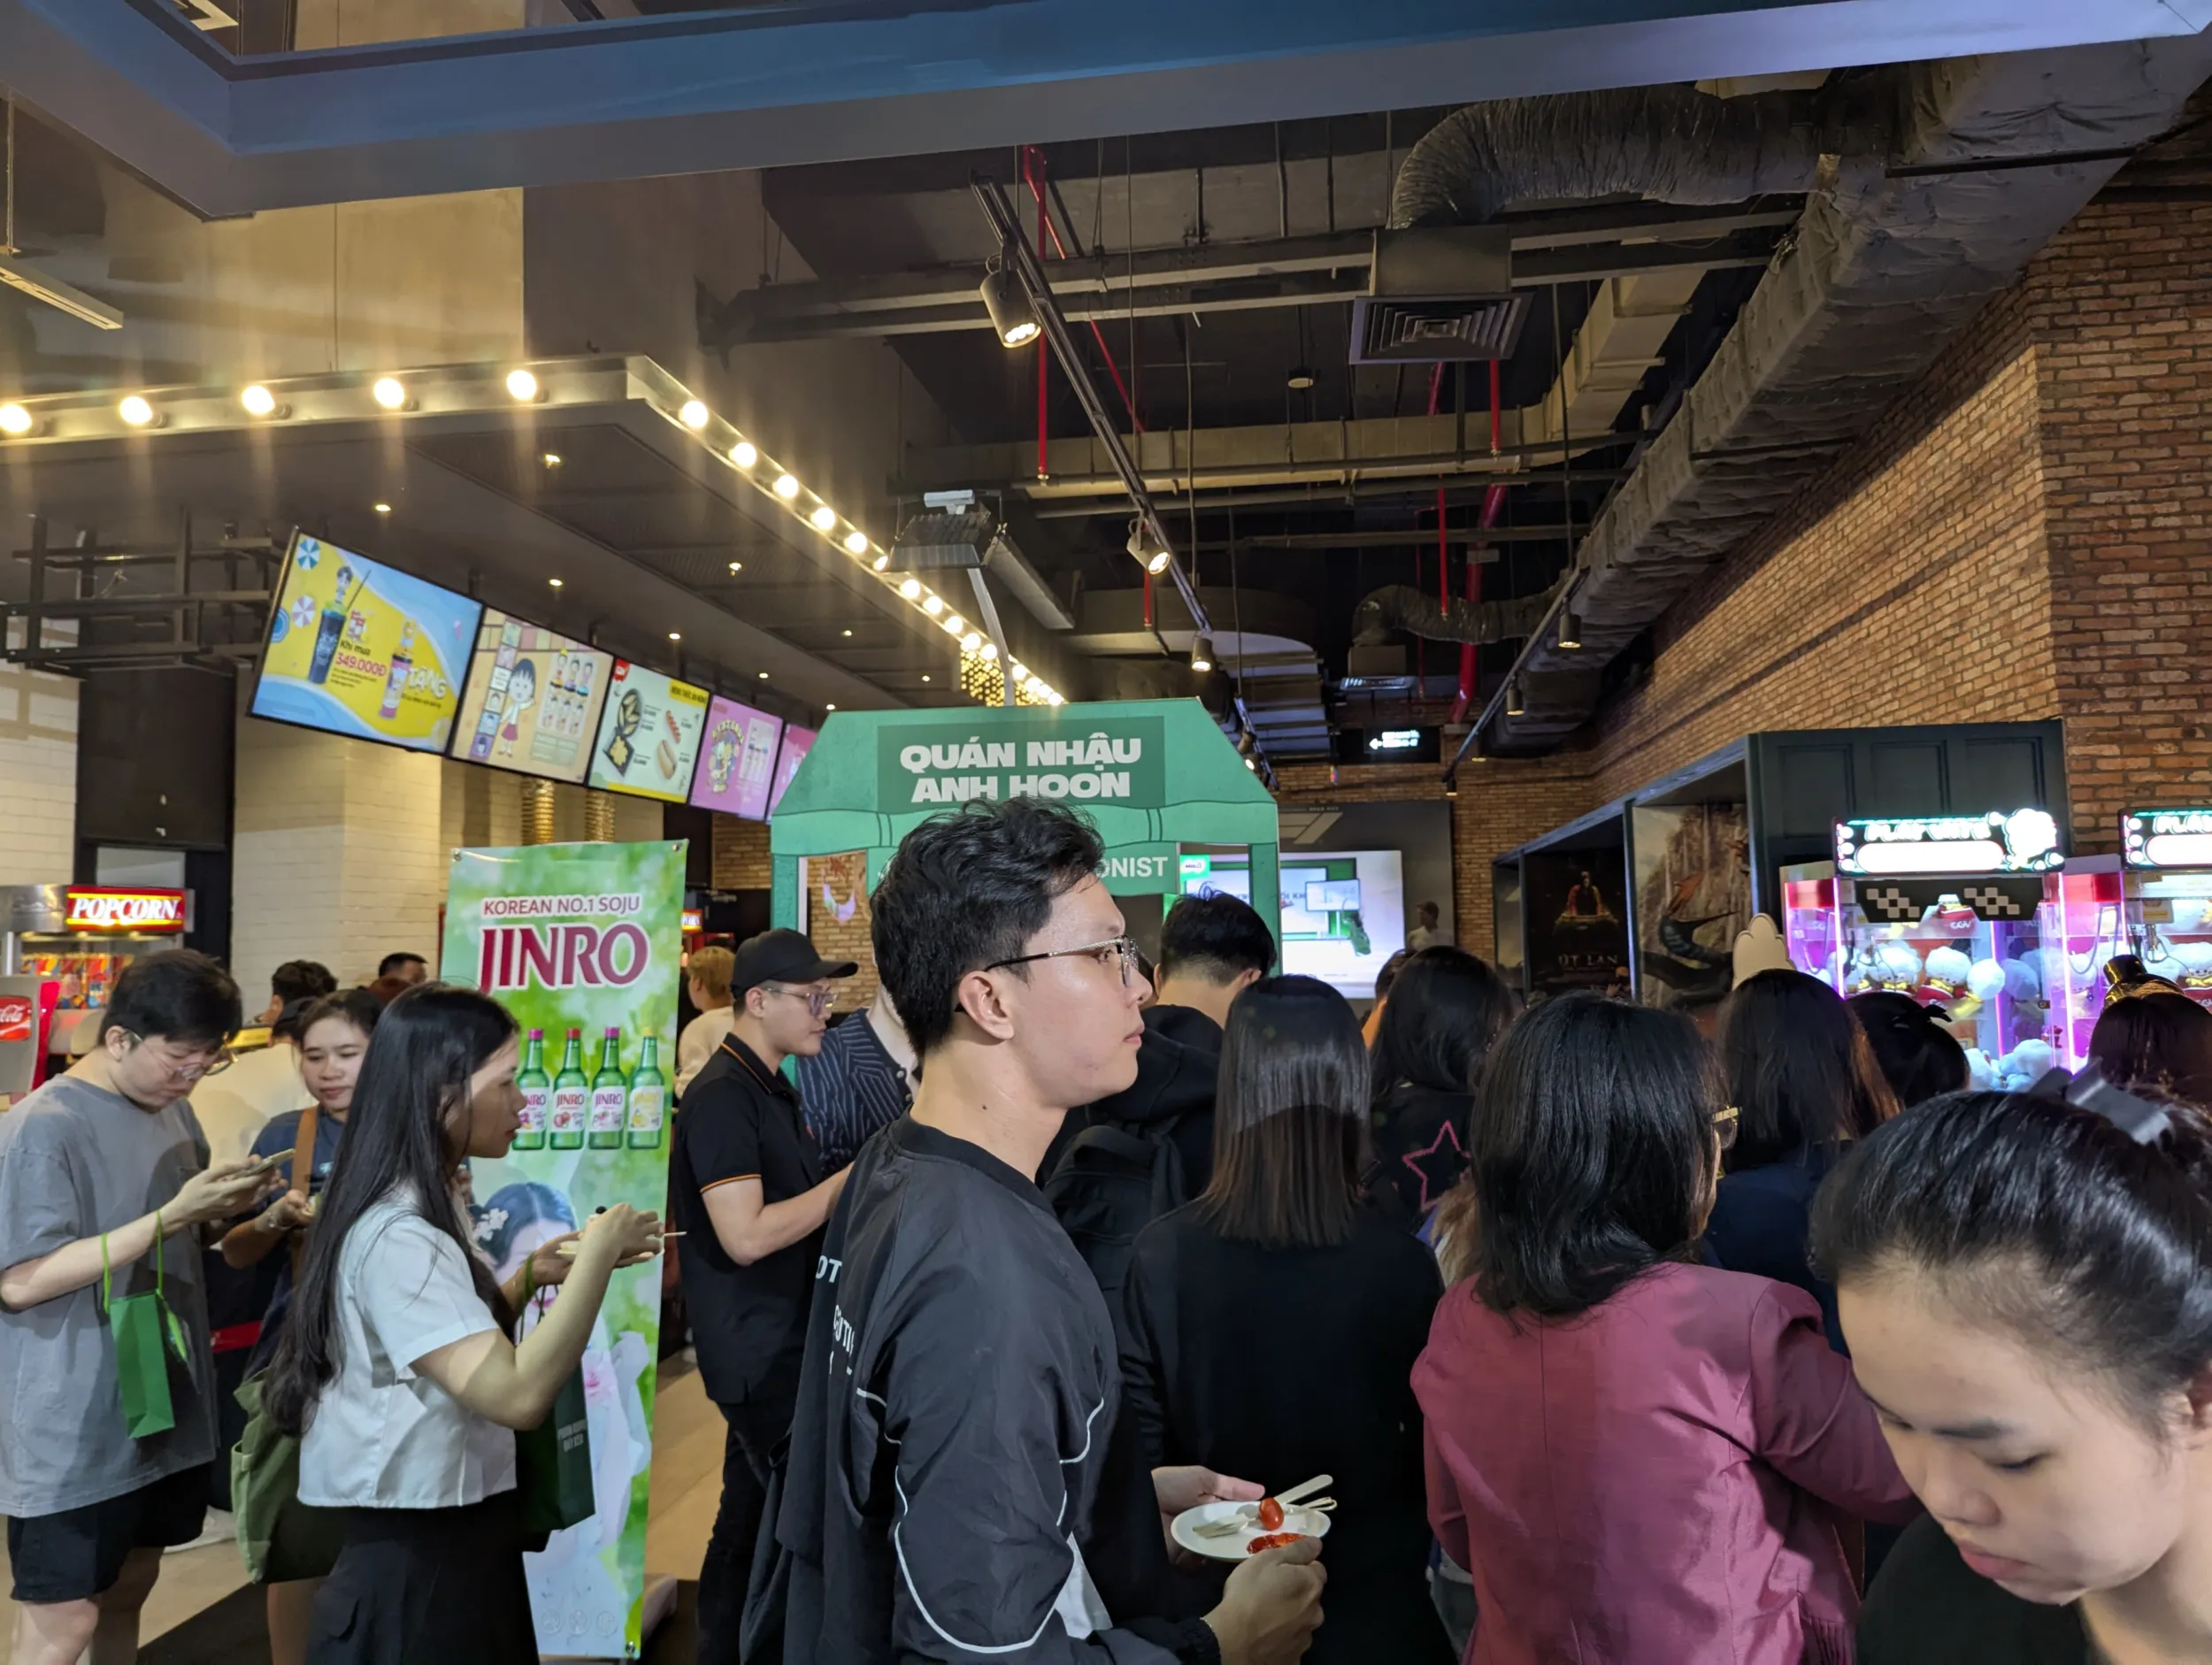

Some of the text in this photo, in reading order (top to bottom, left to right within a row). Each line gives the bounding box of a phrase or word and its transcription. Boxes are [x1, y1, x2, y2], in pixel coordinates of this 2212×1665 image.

[900, 732, 1142, 773] QUÁN NHẬU
[911, 771, 1131, 803] ANH HOON
[73, 898, 180, 920] POPCORN
[483, 895, 641, 915] KOREAN NO.1 SOJU
[1949, 920, 1972, 929] CGV
[478, 923, 649, 996] JINRO
[557, 1093, 585, 1108] JINRO
[595, 1093, 623, 1108] JINRO
